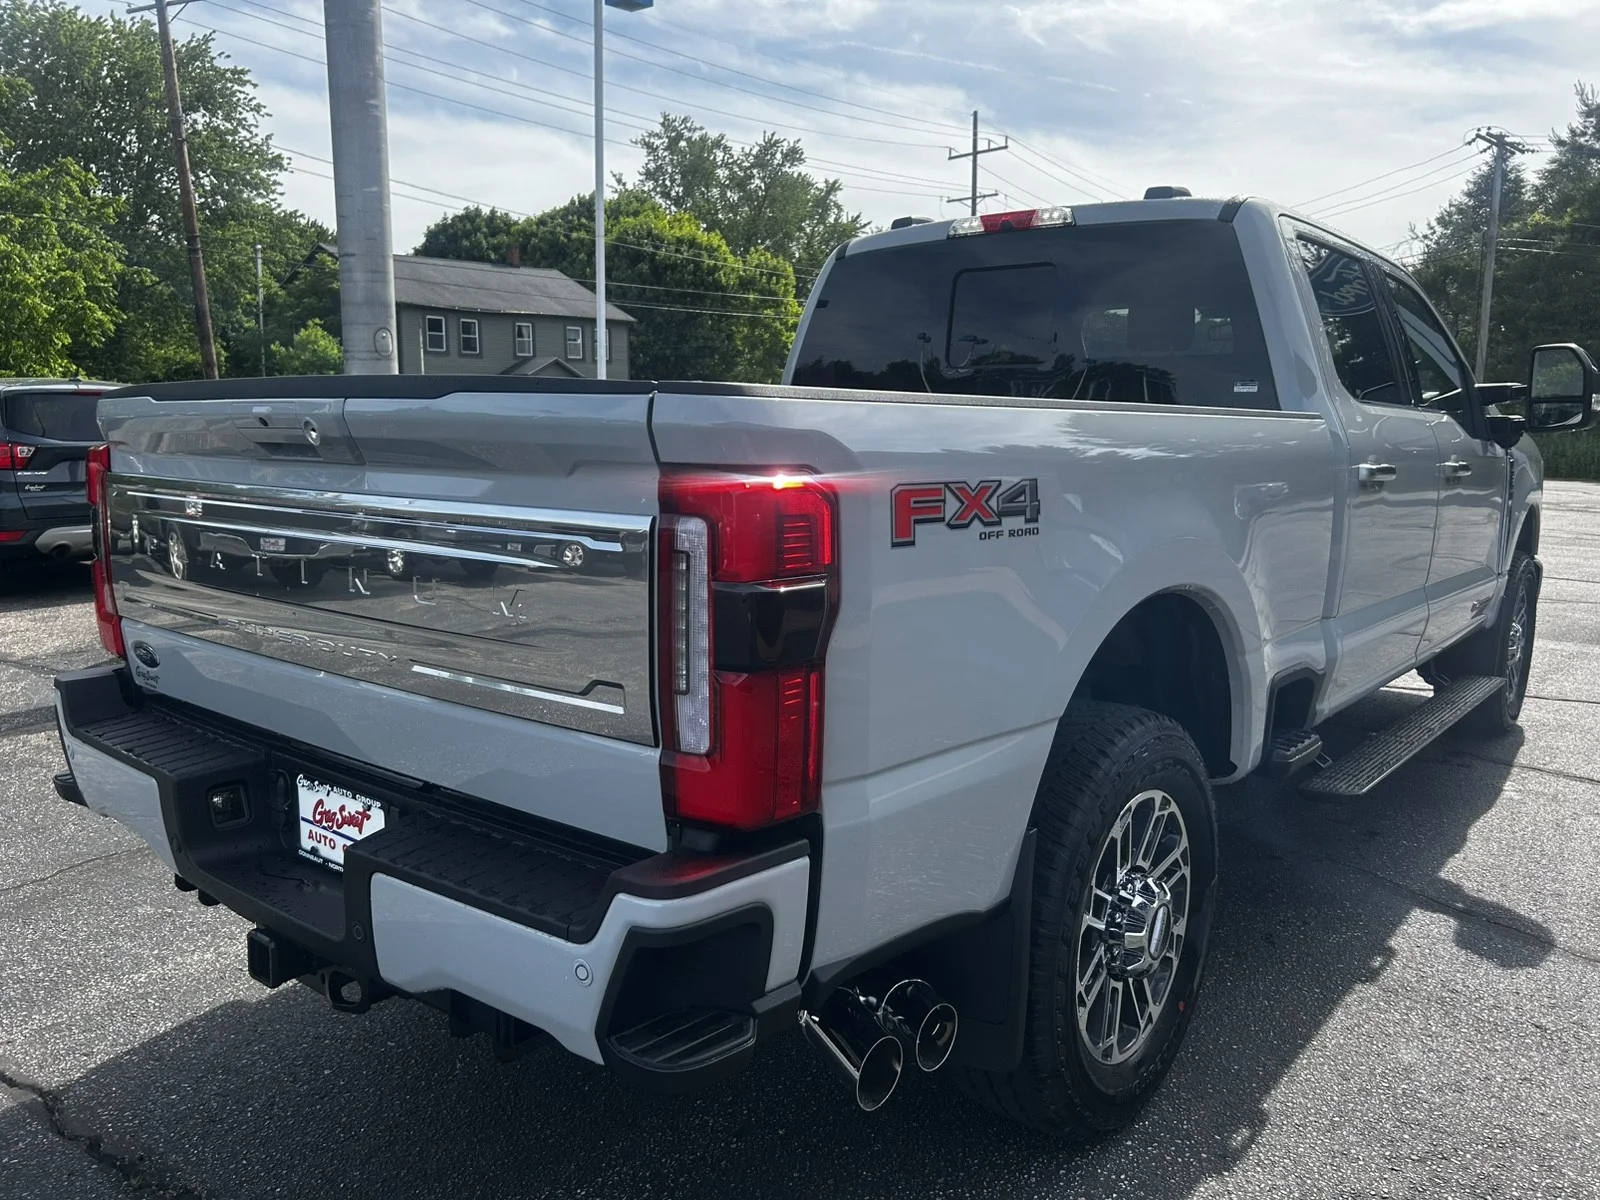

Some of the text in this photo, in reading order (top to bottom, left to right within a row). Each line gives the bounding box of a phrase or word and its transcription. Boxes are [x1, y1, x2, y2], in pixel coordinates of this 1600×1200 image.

[891, 478, 1040, 547] FX4
[979, 526, 1040, 541] OFF ROAD
[226, 618, 311, 647] SUPER
[333, 786, 353, 798] AUTO
[355, 794, 381, 807] GROUP
[308, 829, 336, 849] AUTO
